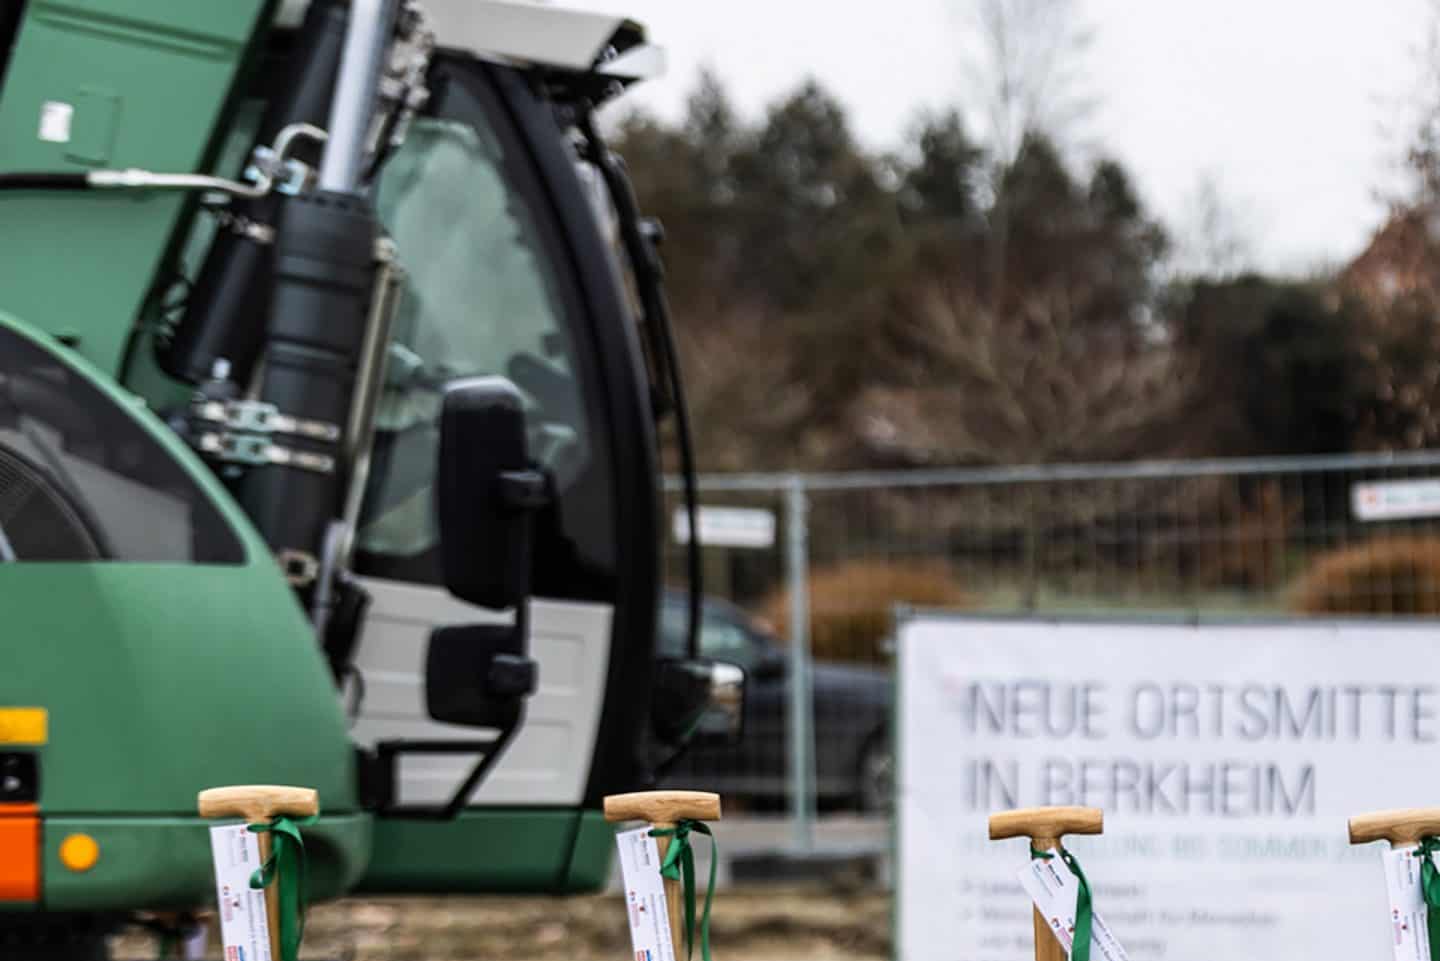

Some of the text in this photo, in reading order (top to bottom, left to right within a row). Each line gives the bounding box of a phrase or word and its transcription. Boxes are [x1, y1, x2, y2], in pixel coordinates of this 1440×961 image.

[966, 681, 1438, 742] NEUE ORTSMITTE
[967, 759, 1315, 817] IN BERKHEIM
